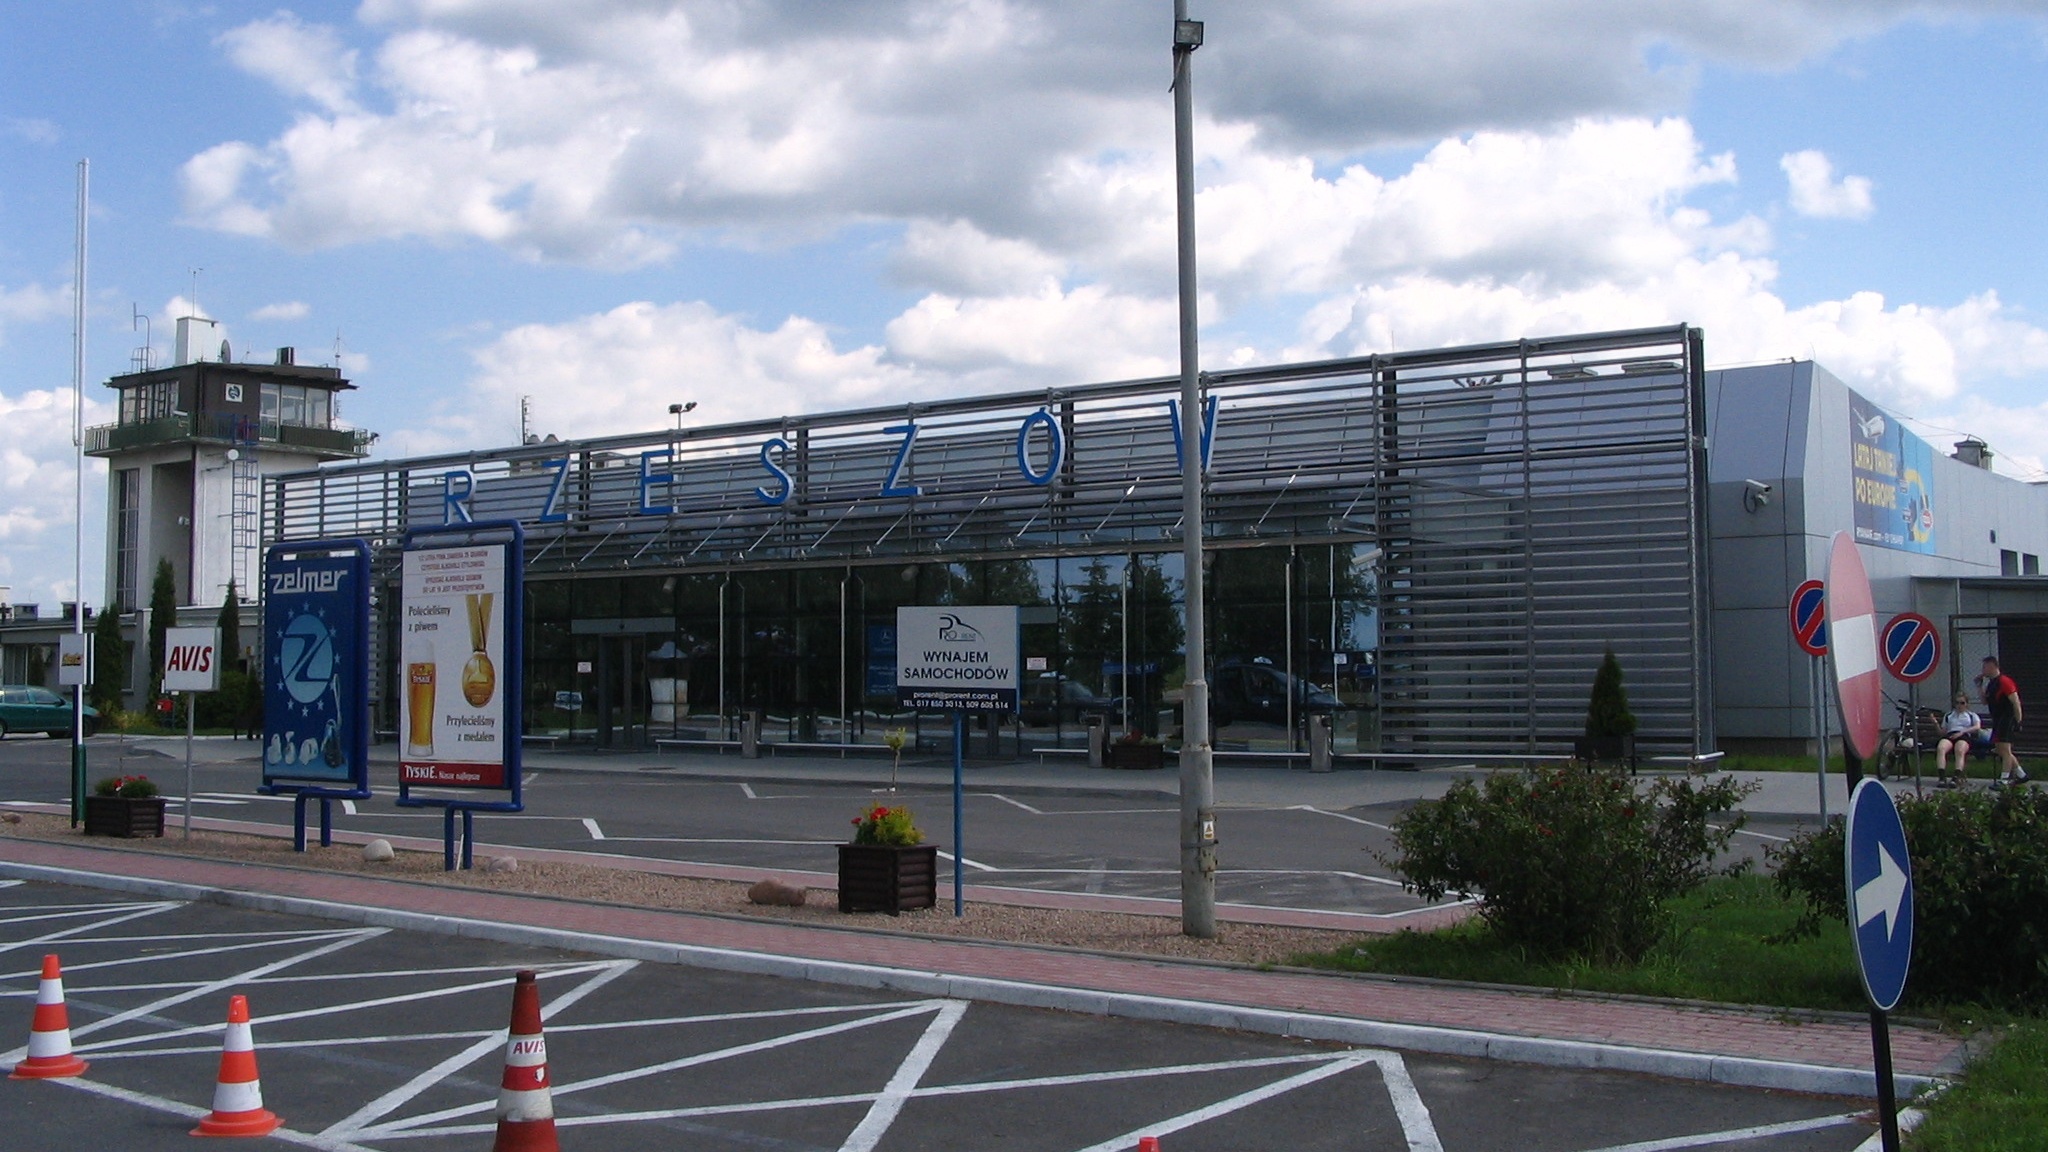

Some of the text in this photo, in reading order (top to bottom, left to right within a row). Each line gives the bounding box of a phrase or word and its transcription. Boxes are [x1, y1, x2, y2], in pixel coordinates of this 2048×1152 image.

[270, 567, 348, 594] zelmer
[414, 622, 438, 632] piwem
[167, 646, 213, 673] AVIS
[923, 650, 989, 663] WYNAJEM
[904, 665, 1009, 680] SAMOCHODÓW
[916, 700, 929, 708] 017
[464, 732, 495, 741] medalem
[513, 1041, 545, 1055] AVIS
